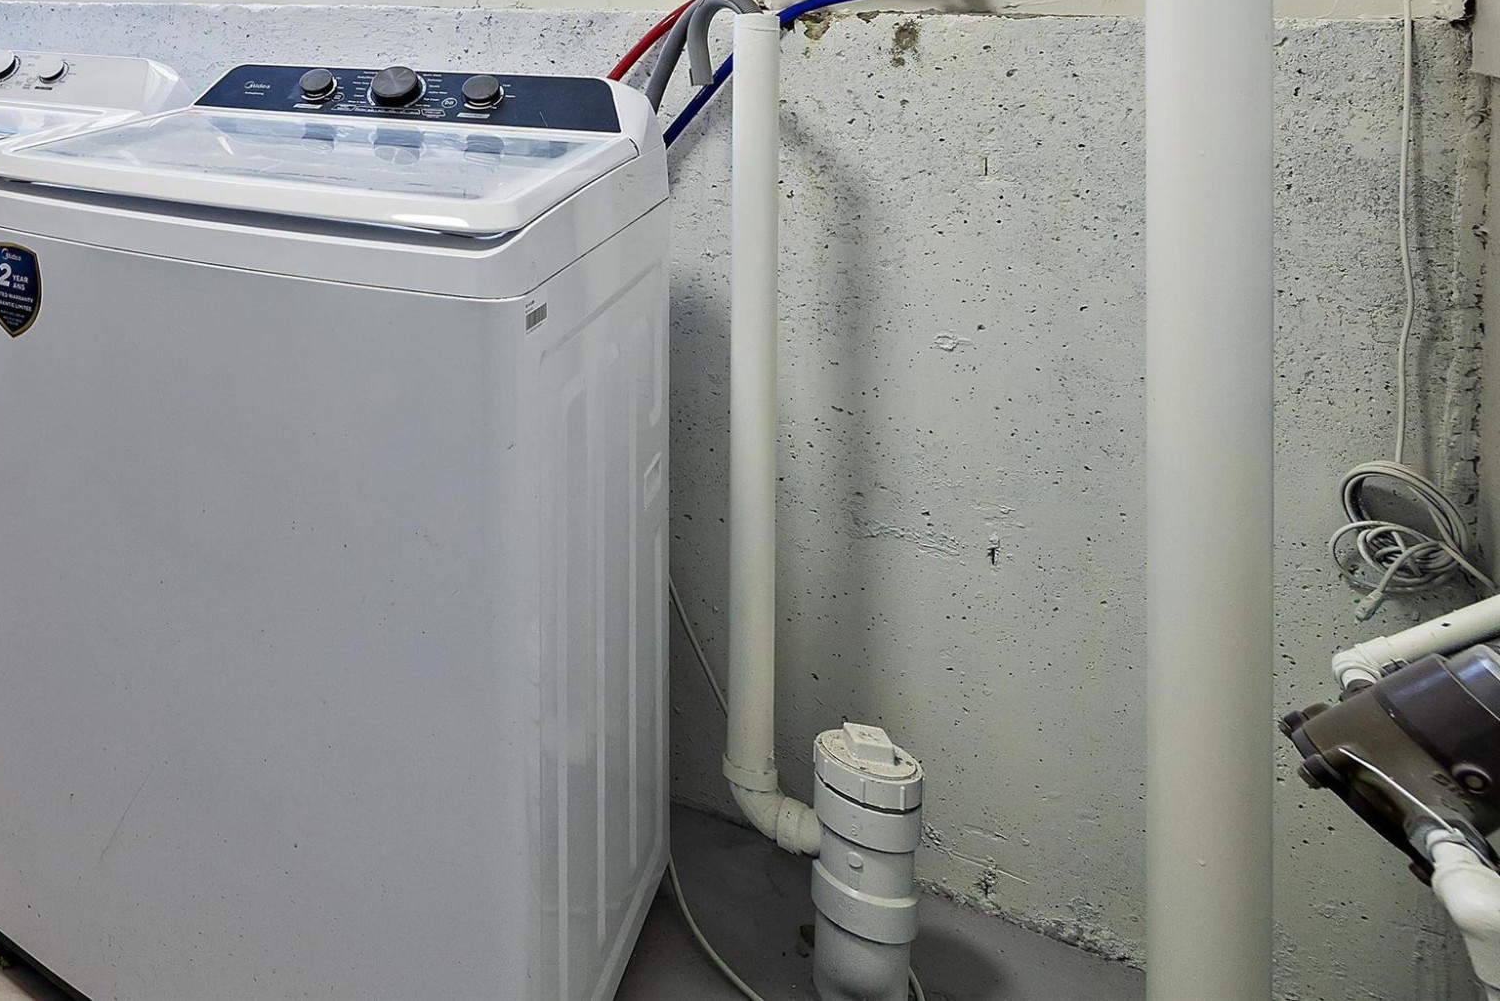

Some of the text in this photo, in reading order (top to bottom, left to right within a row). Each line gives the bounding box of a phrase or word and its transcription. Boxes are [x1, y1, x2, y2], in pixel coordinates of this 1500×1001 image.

[244, 81, 271, 89] Midea
[1, 247, 22, 261] Midea
[12, 274, 29, 283] YEAR
[13, 282, 25, 291] ANS
[9, 293, 34, 303] WARRANTY
